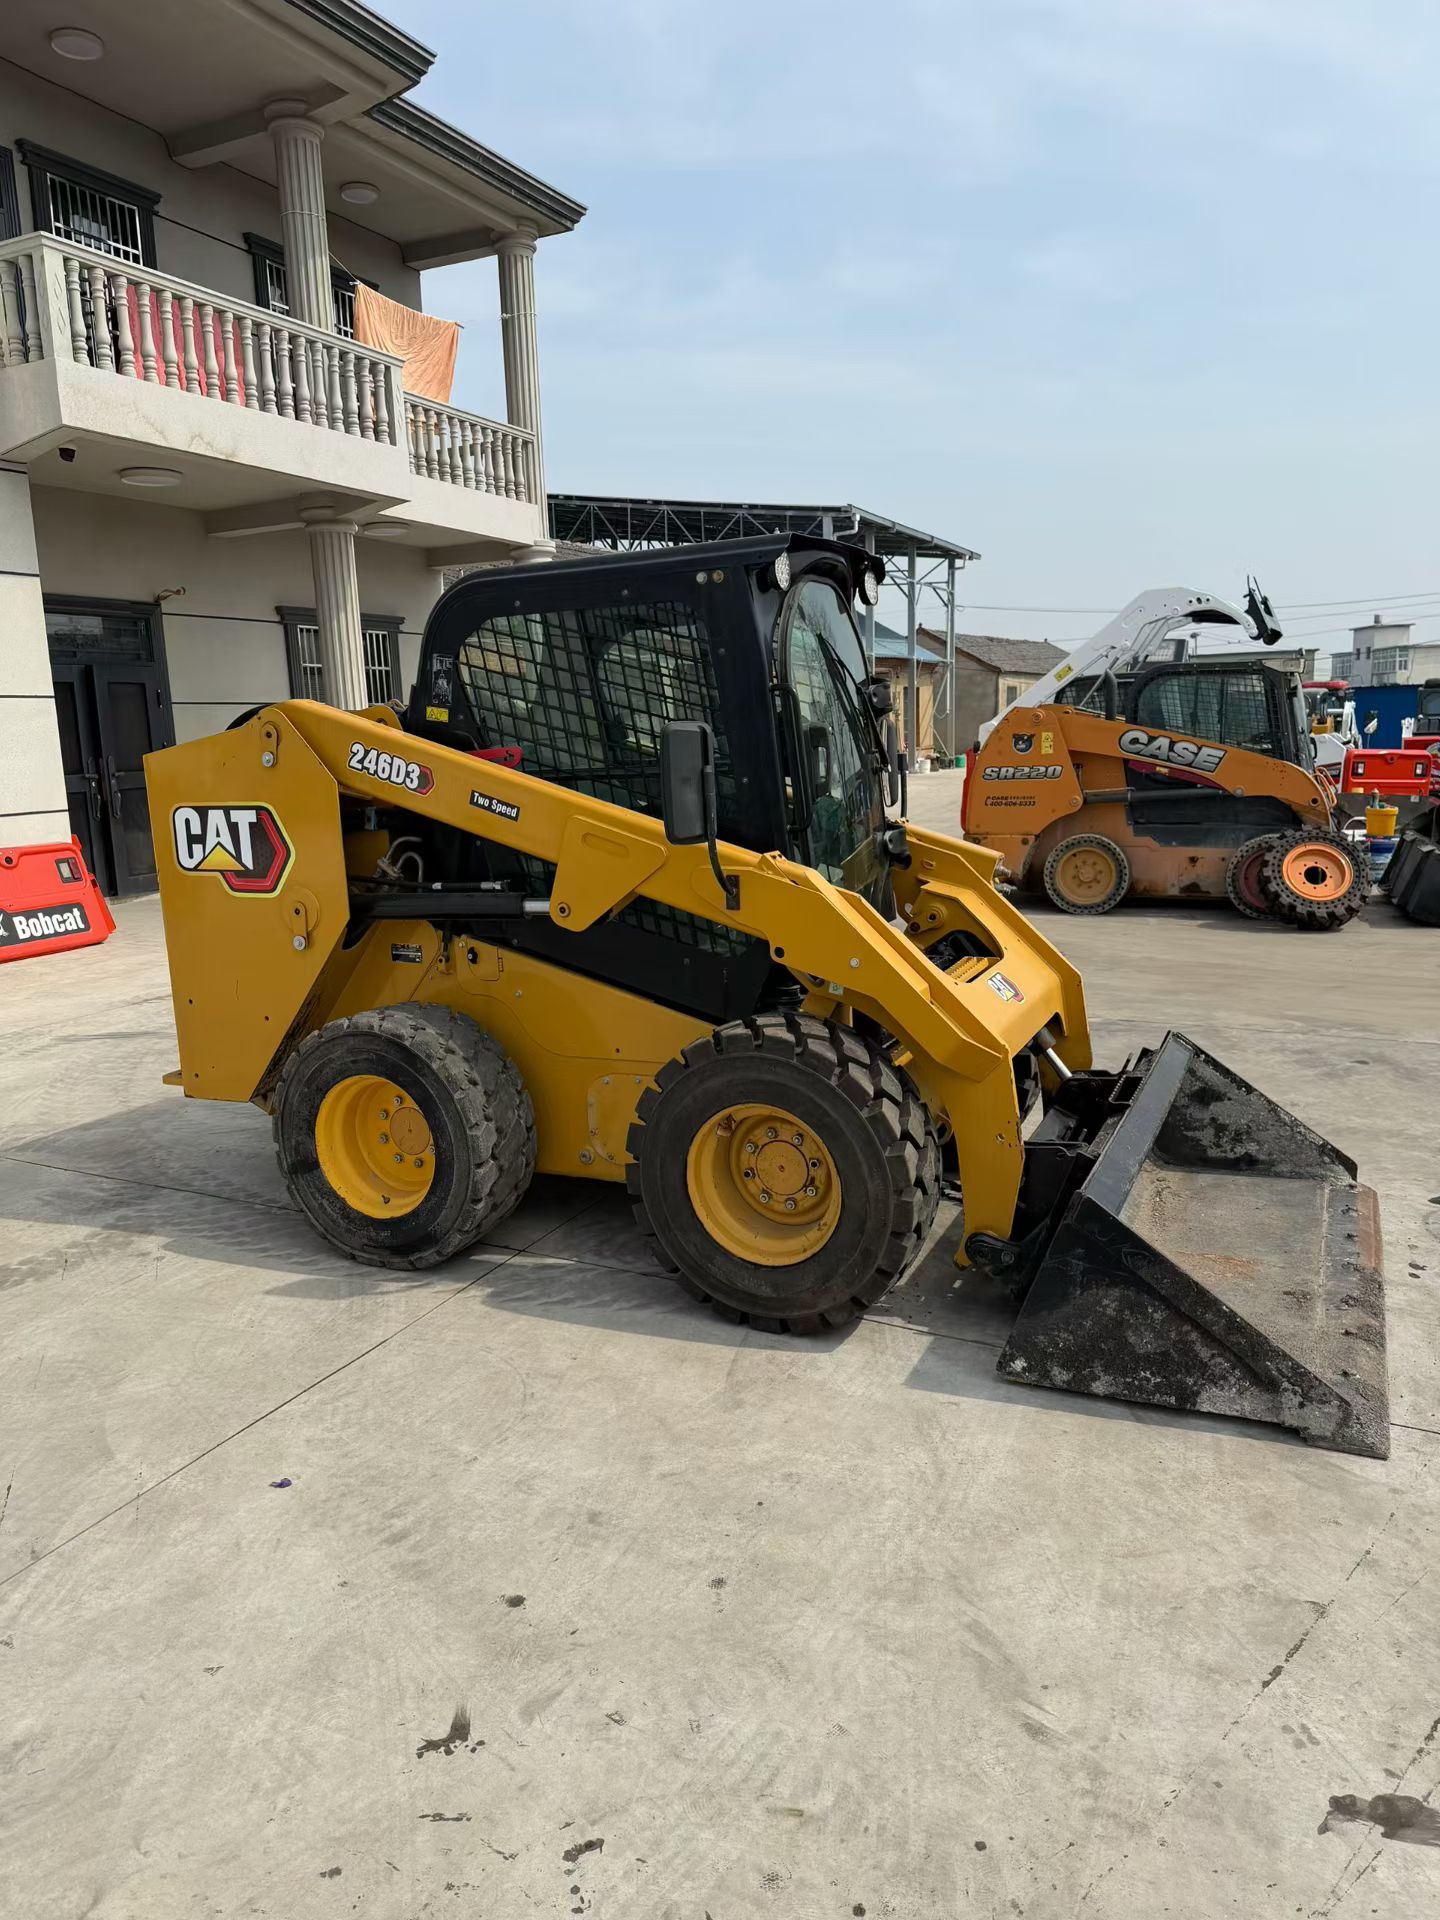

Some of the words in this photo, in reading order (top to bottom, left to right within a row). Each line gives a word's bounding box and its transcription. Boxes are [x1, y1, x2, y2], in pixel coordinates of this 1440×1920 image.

[348, 743, 421, 790] 246D3
[1119, 729, 1227, 773] CASE
[983, 765, 1063, 780] SR220
[473, 792, 490, 807] Two
[491, 799, 518, 818] Speed
[174, 807, 258, 871] CAT
[12, 907, 85, 940] Bobcat
